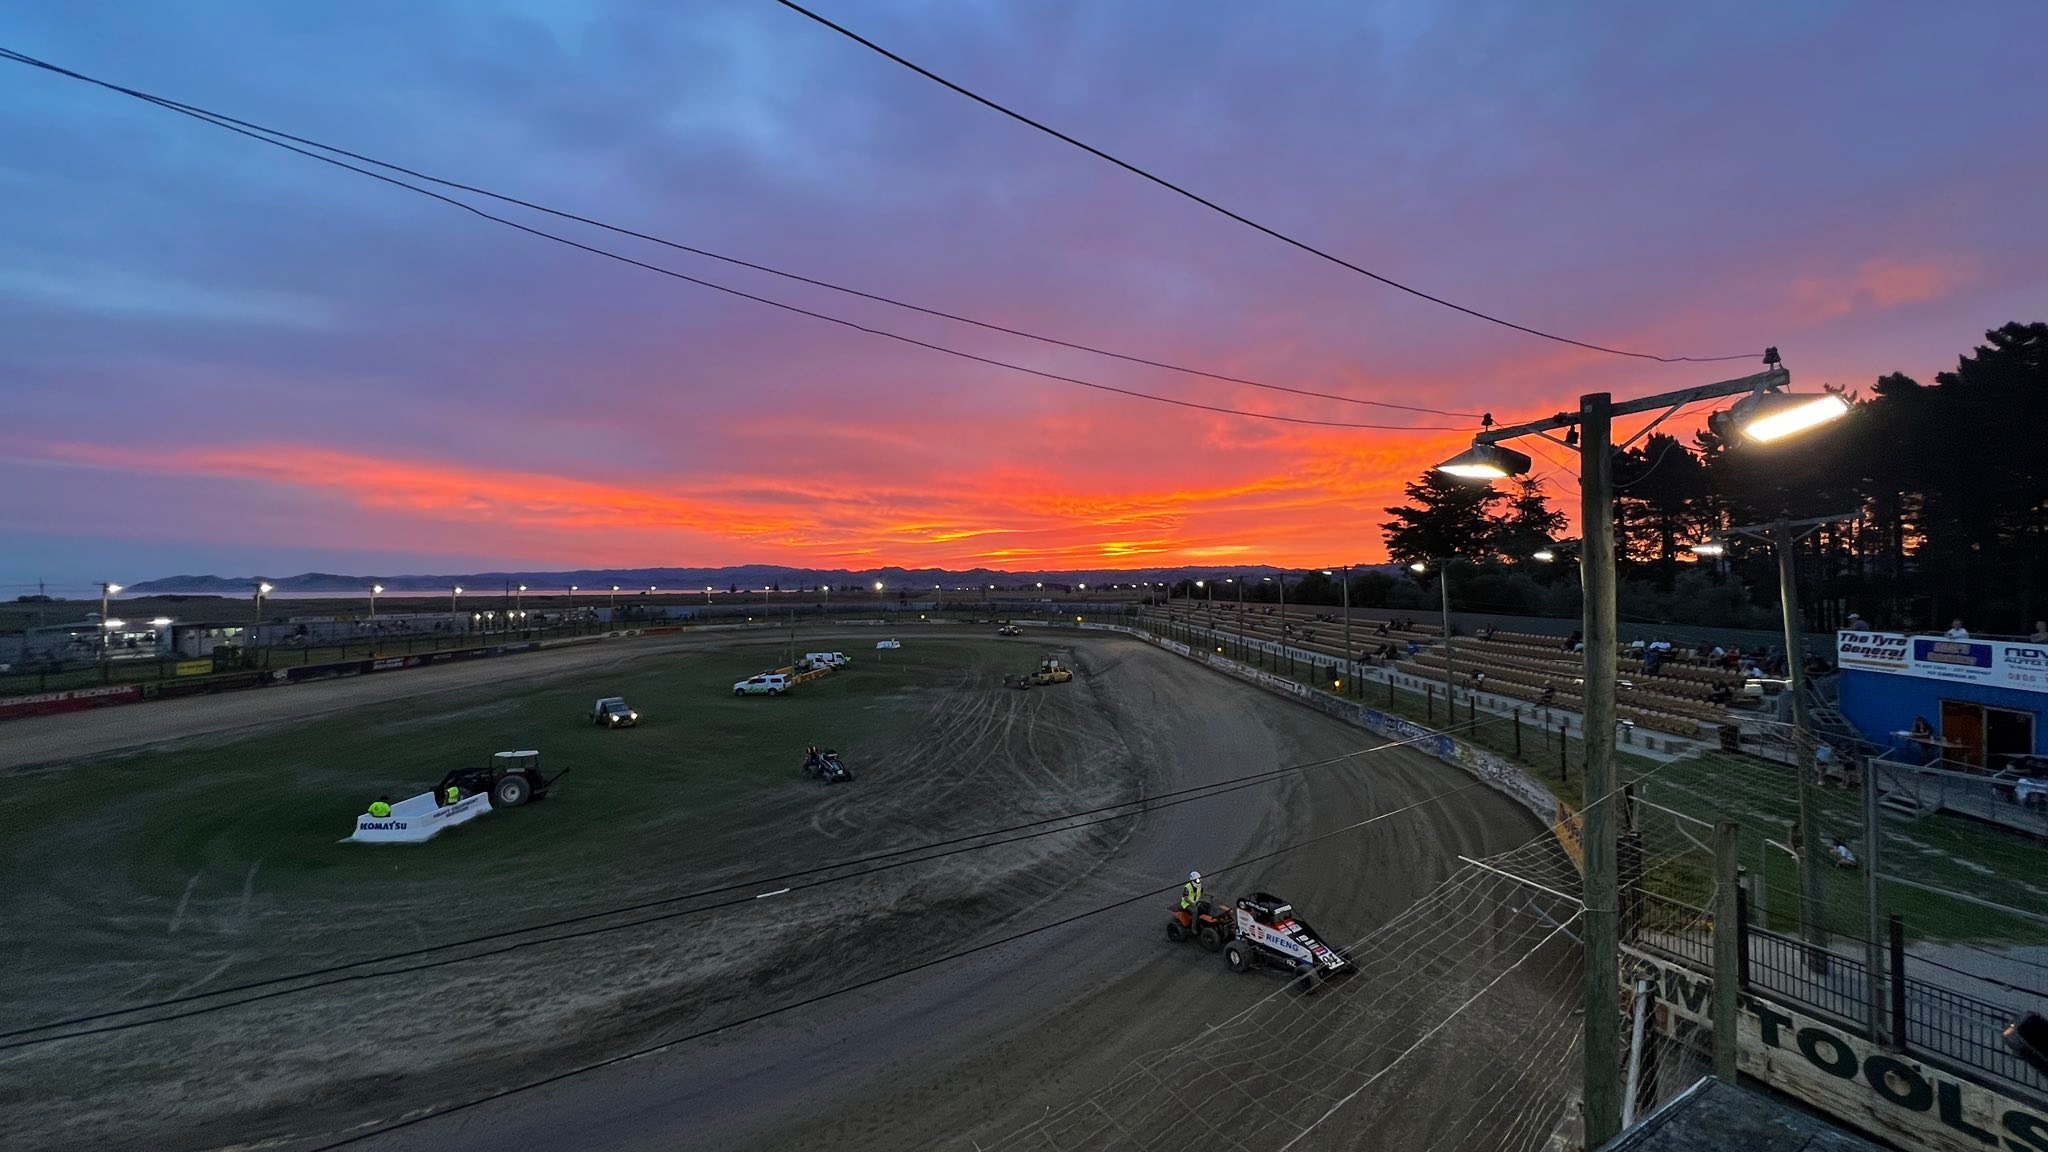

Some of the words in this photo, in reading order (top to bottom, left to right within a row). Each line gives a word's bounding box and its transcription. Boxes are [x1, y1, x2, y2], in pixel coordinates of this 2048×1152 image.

[1841, 633, 1869, 643] The
[1872, 635, 1907, 646] Tyre
[1841, 643, 1906, 657] General
[360, 820, 407, 830] KOMATSU
[1266, 933, 1300, 952] RIFENG
